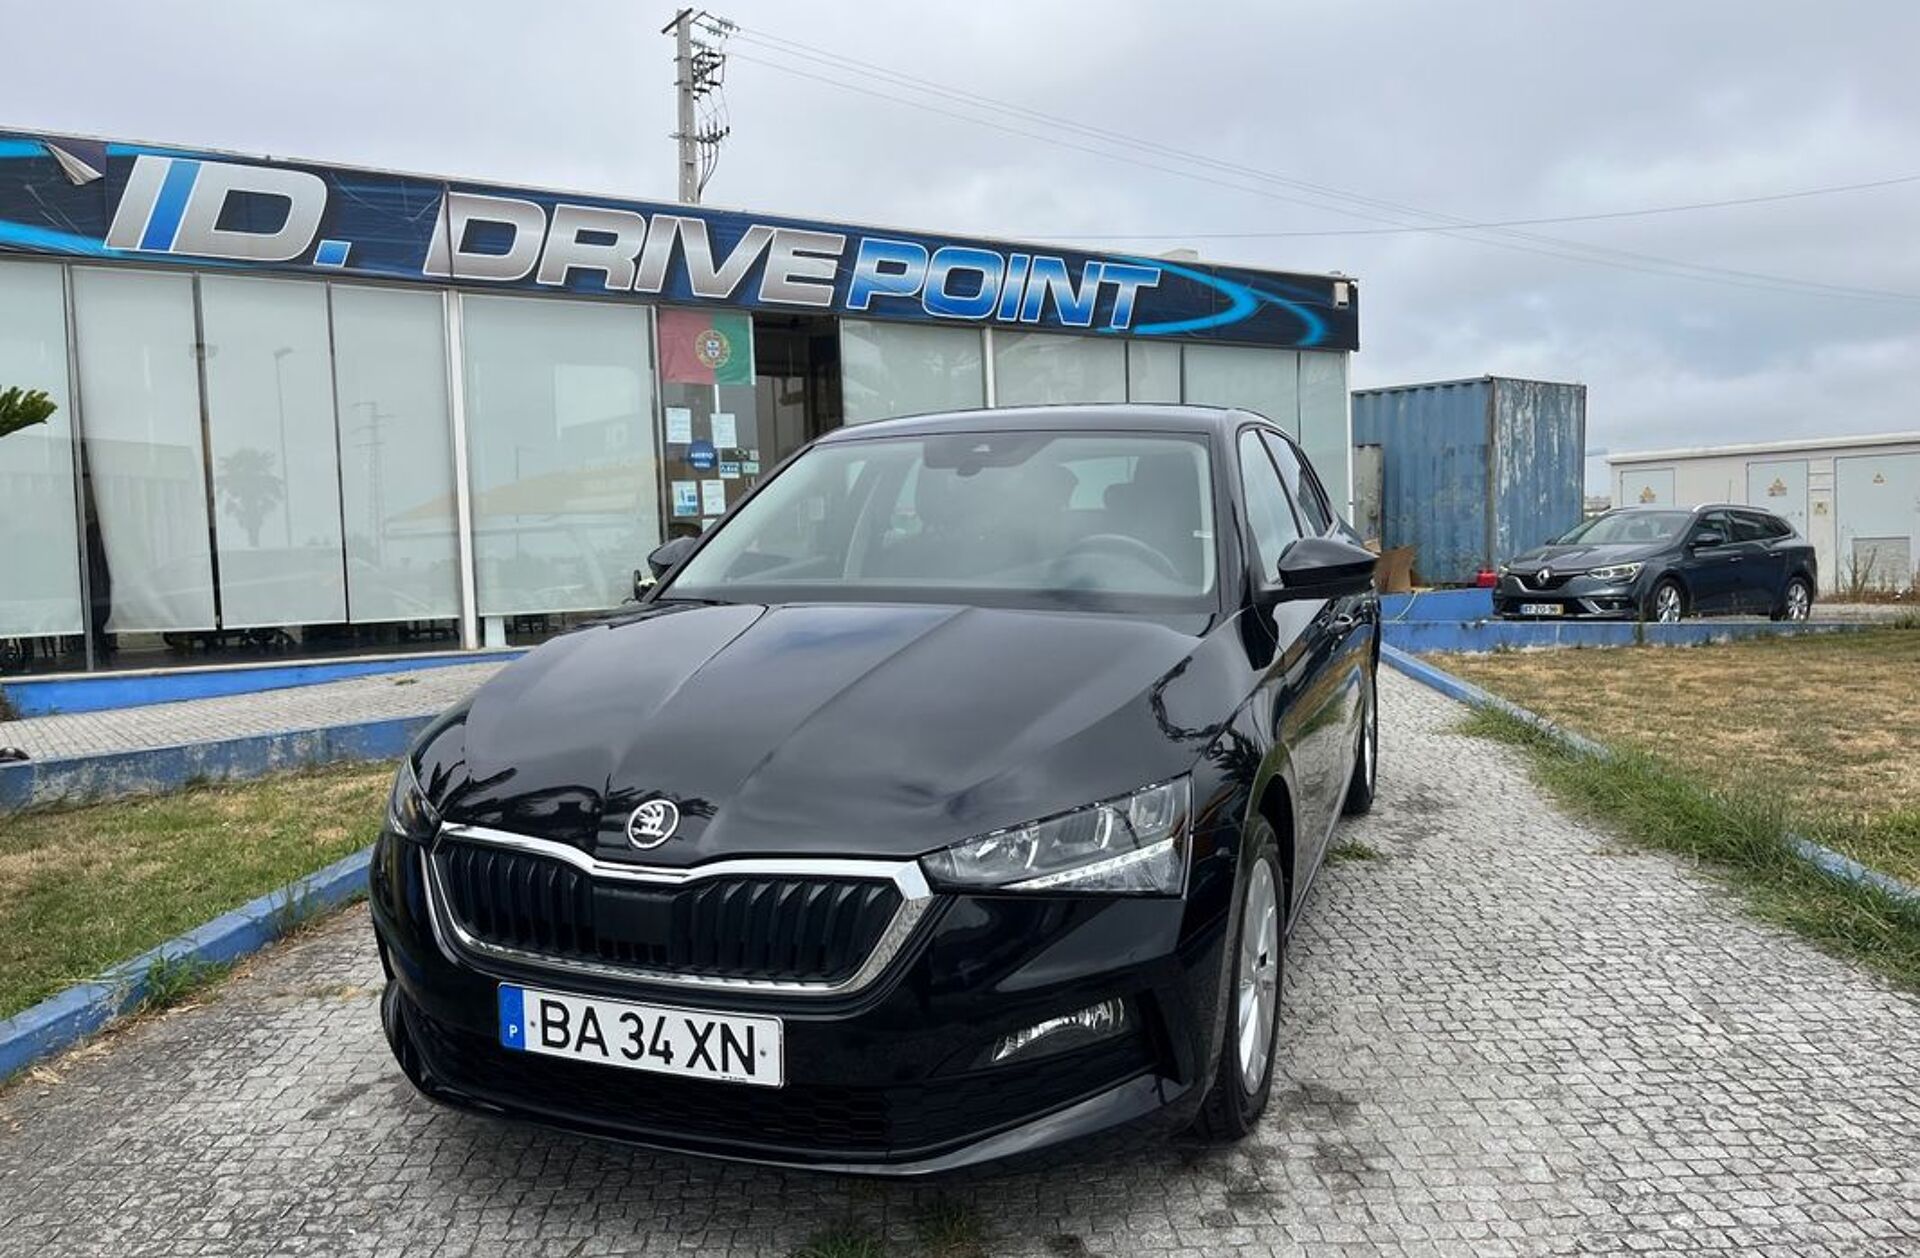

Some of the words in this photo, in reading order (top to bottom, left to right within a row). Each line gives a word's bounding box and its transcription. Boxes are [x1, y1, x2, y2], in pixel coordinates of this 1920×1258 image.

[509, 1025, 518, 1039] P
[540, 999, 609, 1057] BA
[619, 1011, 674, 1066] 34
[684, 1018, 756, 1076] XN
